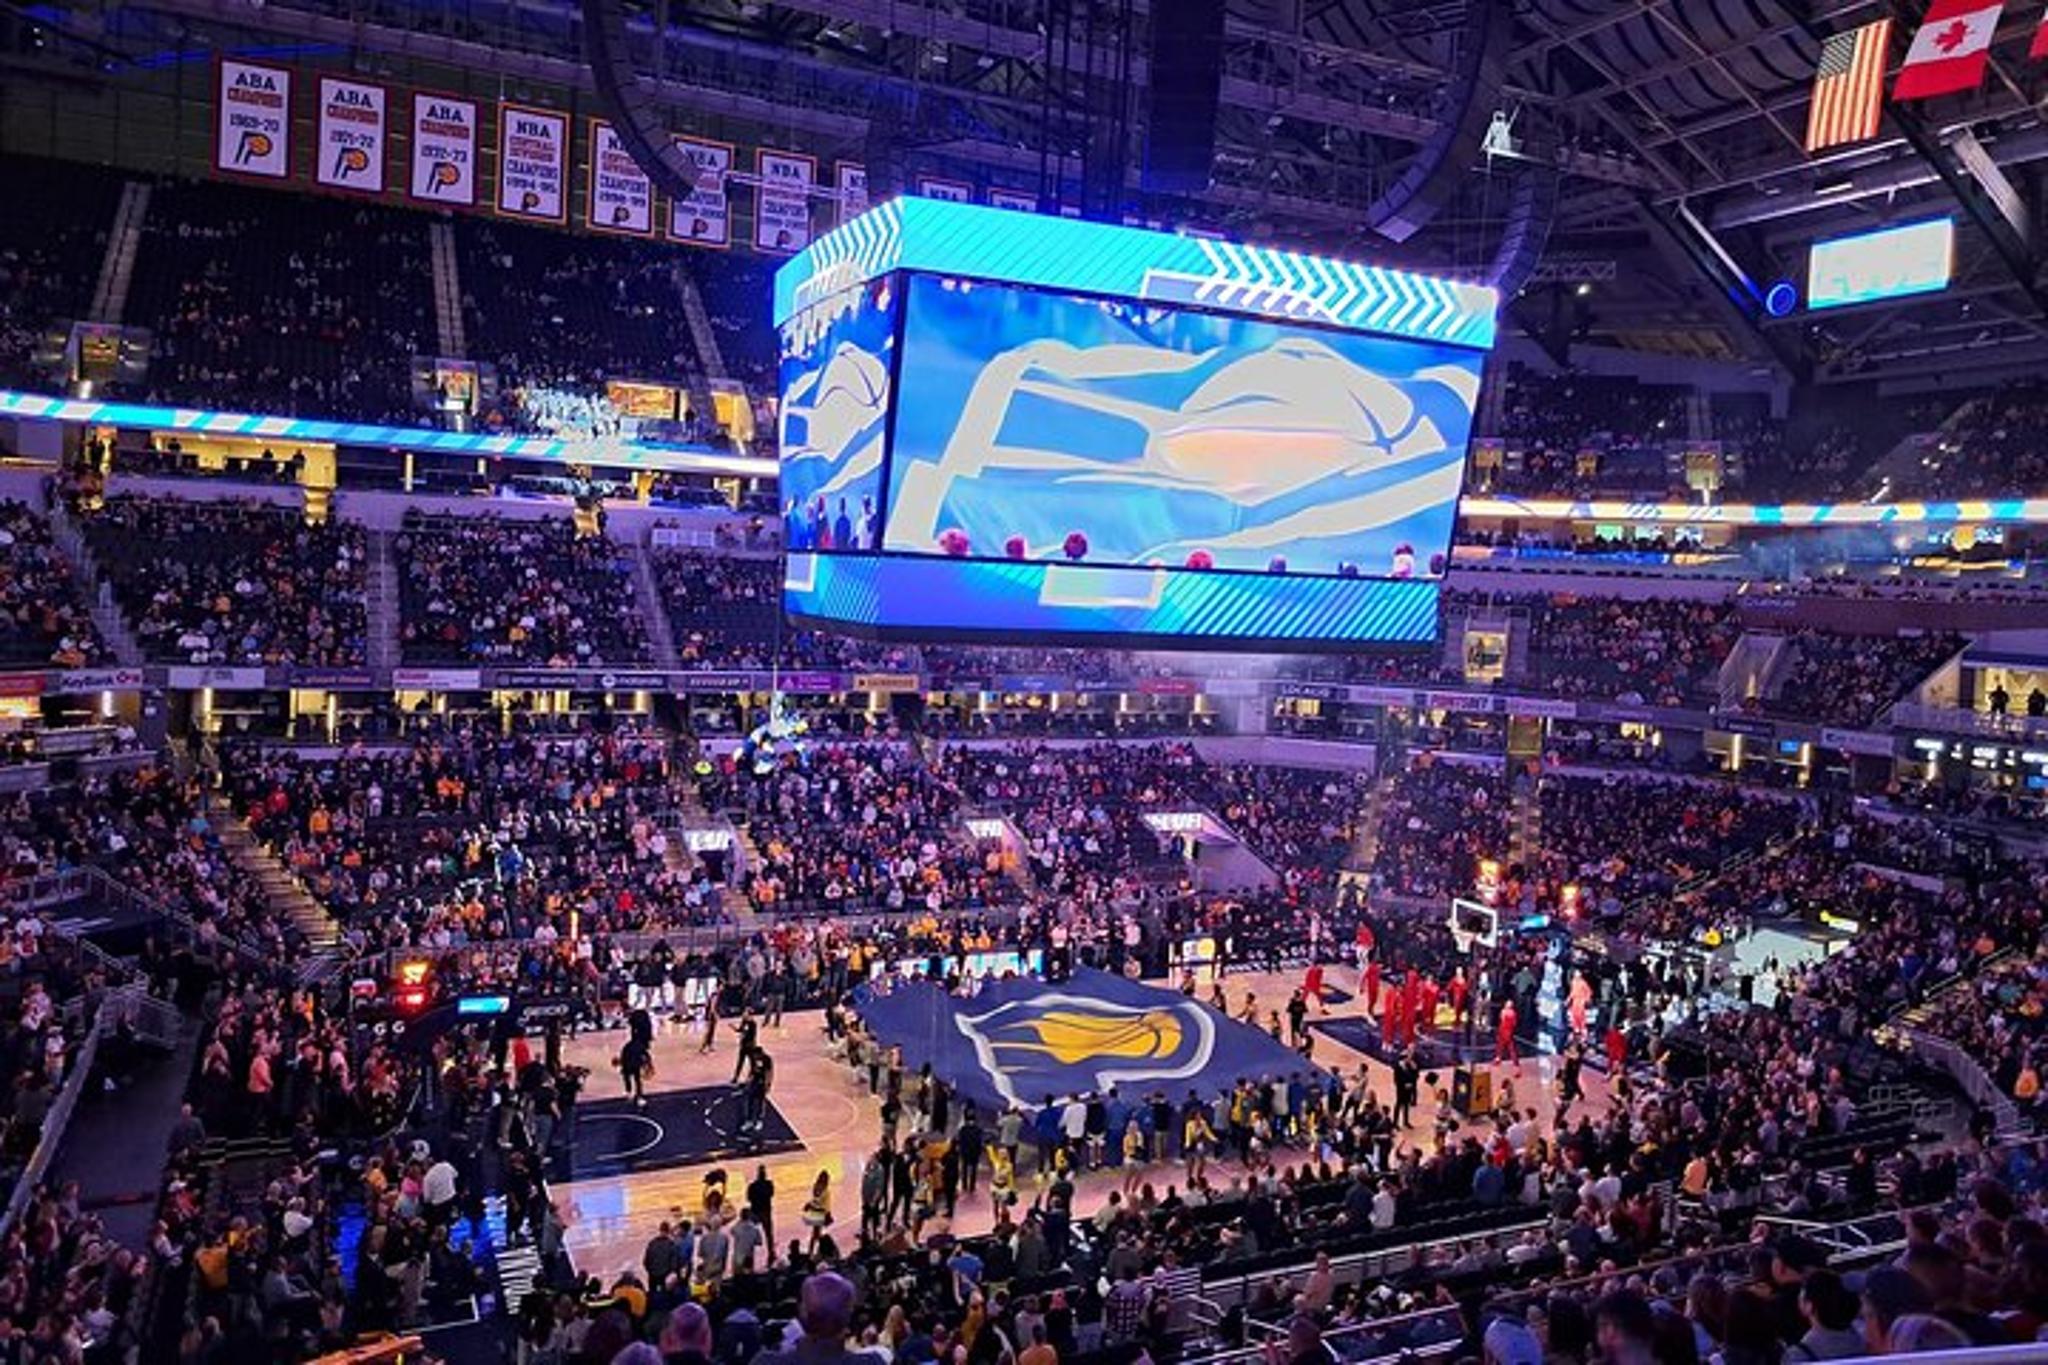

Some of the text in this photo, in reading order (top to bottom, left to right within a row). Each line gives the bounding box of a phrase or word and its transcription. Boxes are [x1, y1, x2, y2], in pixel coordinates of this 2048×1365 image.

[236, 72, 276, 91] ABA
[334, 89, 373, 108] ABA
[426, 104, 464, 122] ABA
[516, 120, 552, 139] NBA
[506, 159, 558, 180] CHAMPIONS
[771, 164, 801, 180] NBA
